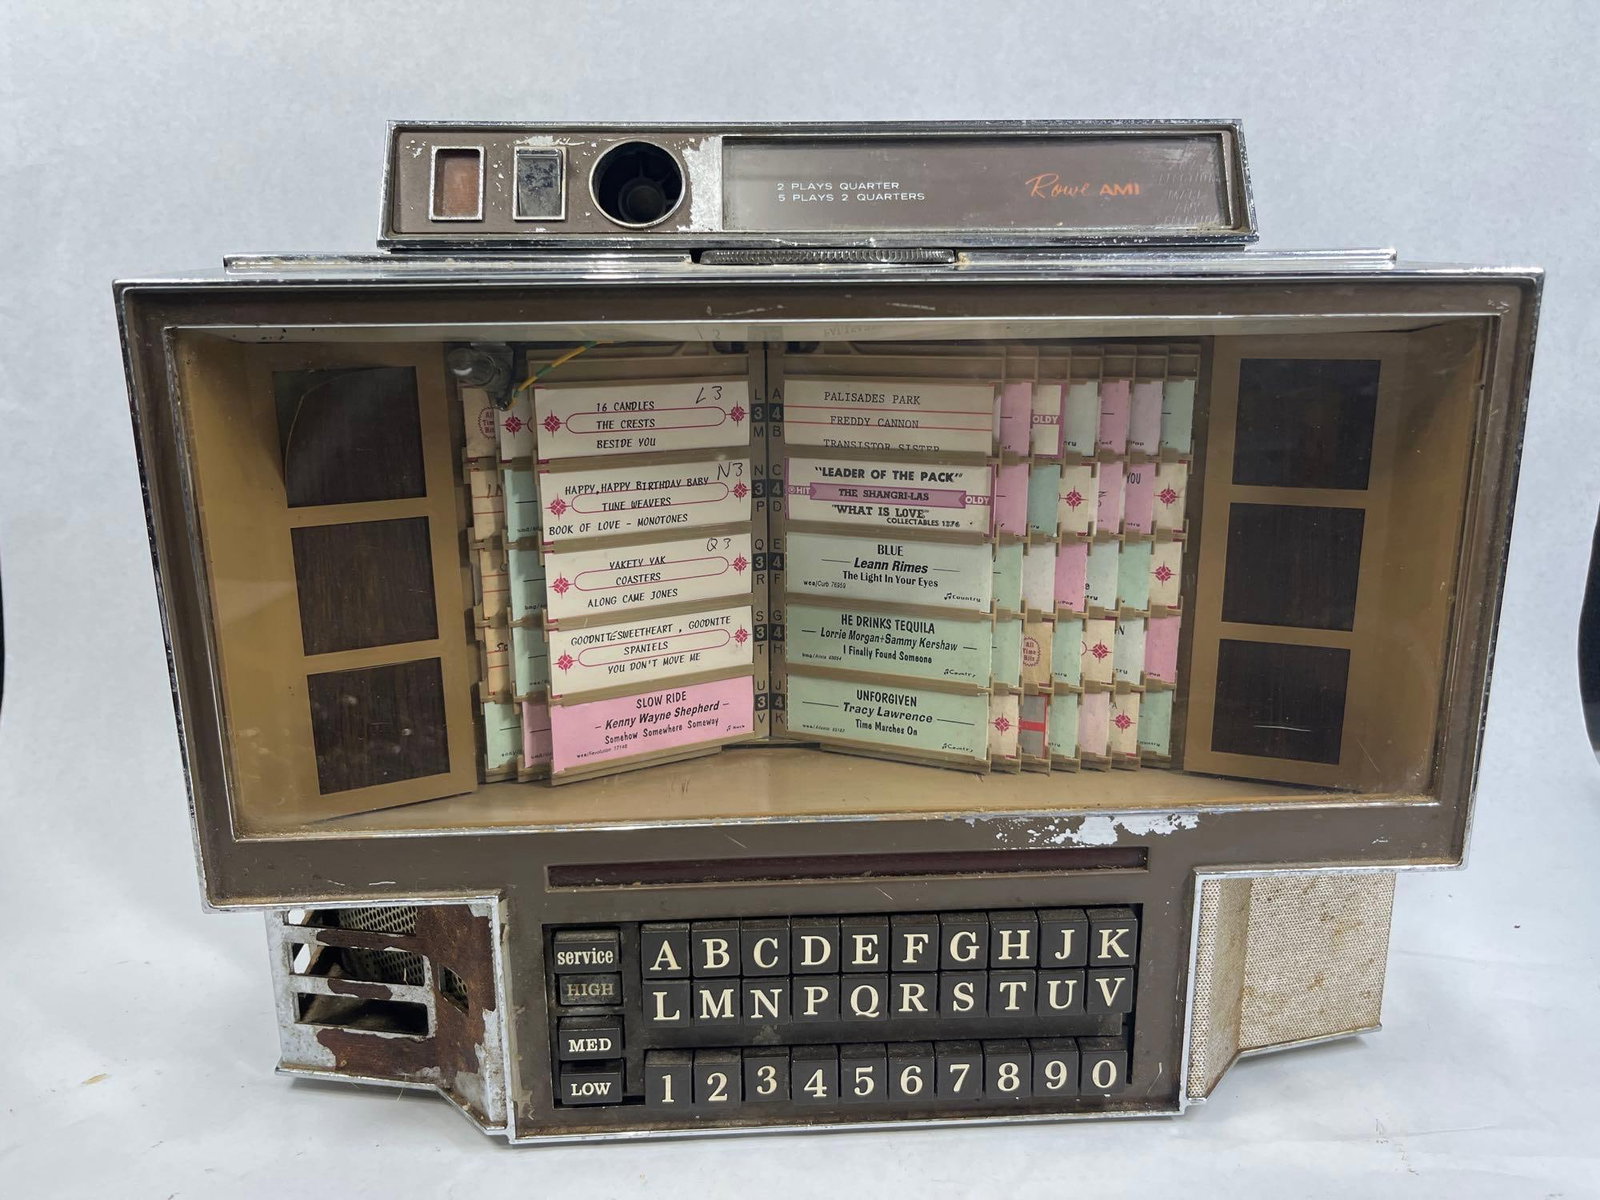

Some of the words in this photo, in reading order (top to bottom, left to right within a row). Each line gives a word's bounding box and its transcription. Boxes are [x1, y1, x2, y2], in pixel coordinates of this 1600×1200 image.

[840, 182, 899, 190] QUARTER
[1025, 173, 1089, 198] Rowe
[1100, 183, 1139, 196] AMI
[857, 193, 925, 201] QUARTERS
[755, 389, 761, 399] L
[773, 389, 781, 399] A
[824, 391, 885, 403] PALISADES
[892, 395, 921, 405] PARK
[596, 402, 608, 412] 16
[613, 401, 655, 411] CANDLES
[754, 407, 762, 419] 3
[772, 407, 781, 419] 4
[596, 420, 615, 430] THE
[620, 419, 655, 429] CRESTS
[830, 416, 870, 426] FREDDY
[877, 418, 919, 429] CANNON
[1033, 415, 1058, 424] OLDY
[754, 427, 763, 437] M
[773, 426, 781, 437] B
[596, 439, 633, 449] BESIDE
[638, 438, 656, 448] YOU
[755, 465, 763, 475] N
[772, 465, 781, 475] C
[871, 469, 887, 479] OF
[892, 470, 914, 480] THE
[636, 478, 682, 491] BIRTHDAY
[687, 477, 709, 486] BABY
[755, 483, 762, 494] 3
[772, 483, 781, 494] 4
[838, 488, 858, 497] THE
[863, 490, 929, 501] SHANGRI-LAS
[965, 496, 990, 504] OLDY
[602, 502, 626, 512] TUNE
[631, 497, 672, 509] WEAVERS
[757, 501, 764, 511] P
[773, 501, 781, 511] D
[878, 507, 890, 516] IS
[549, 525, 574, 536] BOOK
[579, 523, 591, 533] OF
[598, 520, 620, 531] LOVE
[637, 513, 688, 526] MONOTONES
[887, 517, 939, 527] COLLECTABLES
[755, 539, 763, 550] Q
[774, 539, 781, 549] E
[877, 544, 904, 557] BLUE
[756, 556, 763, 568] 3
[773, 556, 781, 568] 4
[854, 557, 889, 571] Leann
[892, 560, 928, 574] Rimes
[615, 572, 661, 586] COASTERS
[757, 574, 764, 584] R
[775, 574, 781, 584] F
[842, 571, 858, 580] The
[860, 571, 883, 583] Light
[884, 575, 893, 583] In
[895, 576, 917, 585] Your
[918, 578, 938, 588] Eyes
[587, 596, 617, 608] ALONG
[622, 592, 645, 604] CAME
[651, 589, 678, 600] JONES
[756, 611, 763, 621] S
[773, 610, 782, 621] G
[688, 616, 731, 630] GOODNITE
[841, 614, 853, 626] HE
[856, 616, 892, 630] DRINKS
[895, 620, 935, 634] TEQUILA
[757, 627, 764, 638] 3
[774, 626, 782, 638] 4
[820, 627, 847, 640] Lorrie
[919, 637, 958, 651] Kershaw
[624, 641, 669, 656] SPANIELS
[757, 644, 764, 654] T
[774, 644, 782, 654] H
[848, 646, 872, 660] Finally
[875, 649, 896, 660] Found
[899, 650, 932, 664] Someone
[607, 663, 625, 674] YOU
[630, 659, 658, 672] DON'T
[663, 655, 685, 666] MOVE
[689, 652, 701, 662] ME
[757, 681, 765, 691] U
[636, 694, 662, 710] SLOW
[665, 691, 687, 704] RIDE
[758, 696, 765, 707] 3
[774, 696, 782, 707] 4
[856, 689, 917, 707] UNFORGIVEN
[605, 715, 636, 730] Kenny
[638, 710, 671, 727] Wayne
[673, 700, 719, 718] Shepherd
[758, 713, 765, 723] V
[776, 713, 783, 723] K
[843, 702, 874, 717] Tracy
[877, 706, 933, 723] Lawrence
[605, 731, 638, 745] Somehow
[643, 724, 683, 737] Somewhere
[687, 717, 719, 730] Someway
[856, 719, 872, 730] Time
[874, 721, 905, 735] Marches
[907, 726, 918, 736] On
[650, 940, 681, 970] A
[703, 938, 729, 969] B
[753, 937, 778, 968] C
[801, 935, 831, 965] D
[852, 934, 878, 964] E
[902, 934, 928, 963] F
[950, 932, 980, 961] G
[998, 930, 1030, 960] H
[1054, 930, 1075, 960] J
[1098, 928, 1130, 958] K
[557, 948, 614, 965] service
[567, 983, 614, 996] HIGH
[653, 992, 680, 1020] L
[700, 989, 735, 1019] M
[750, 989, 782, 1019] N
[803, 986, 829, 1015] P
[850, 984, 880, 1017] Q
[898, 984, 928, 1012] R
[953, 982, 974, 1011] S
[1000, 982, 1026, 1010] T
[1047, 980, 1077, 1010] U
[1096, 978, 1126, 1006] V
[569, 1038, 612, 1053] MED
[661, 1074, 674, 1102] 1
[707, 1072, 728, 1101] 2
[756, 1066, 777, 1094] 3
[804, 1069, 827, 1097] 4
[854, 1066, 874, 1096] 5
[900, 1066, 923, 1094] 6
[950, 1064, 970, 1092] 7
[998, 1062, 1020, 1092] 8
[1045, 1060, 1068, 1089] 9
[1092, 1060, 1117, 1088] 0
[571, 1082, 611, 1096] LOW
